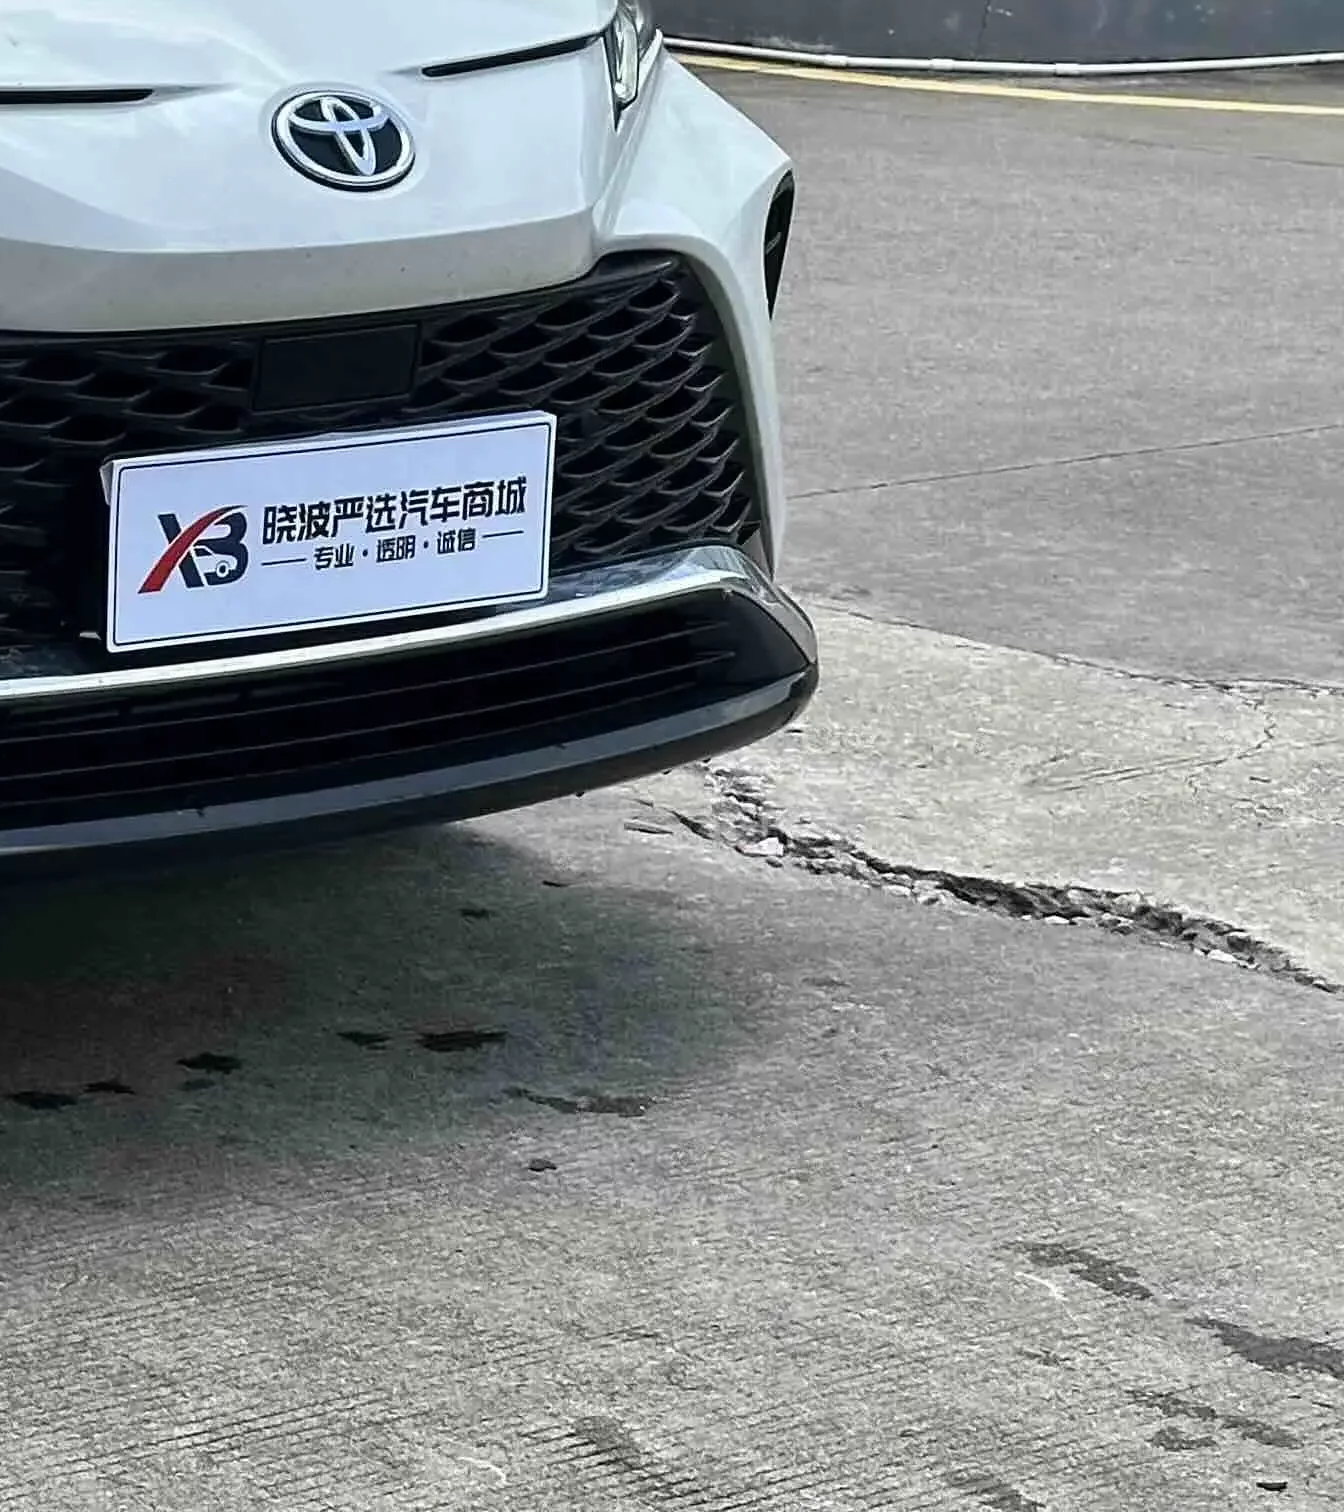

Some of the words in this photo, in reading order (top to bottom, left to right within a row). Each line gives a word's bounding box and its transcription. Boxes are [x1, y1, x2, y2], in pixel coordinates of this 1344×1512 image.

[262, 476, 527, 545] 晓波严选汽车商城
